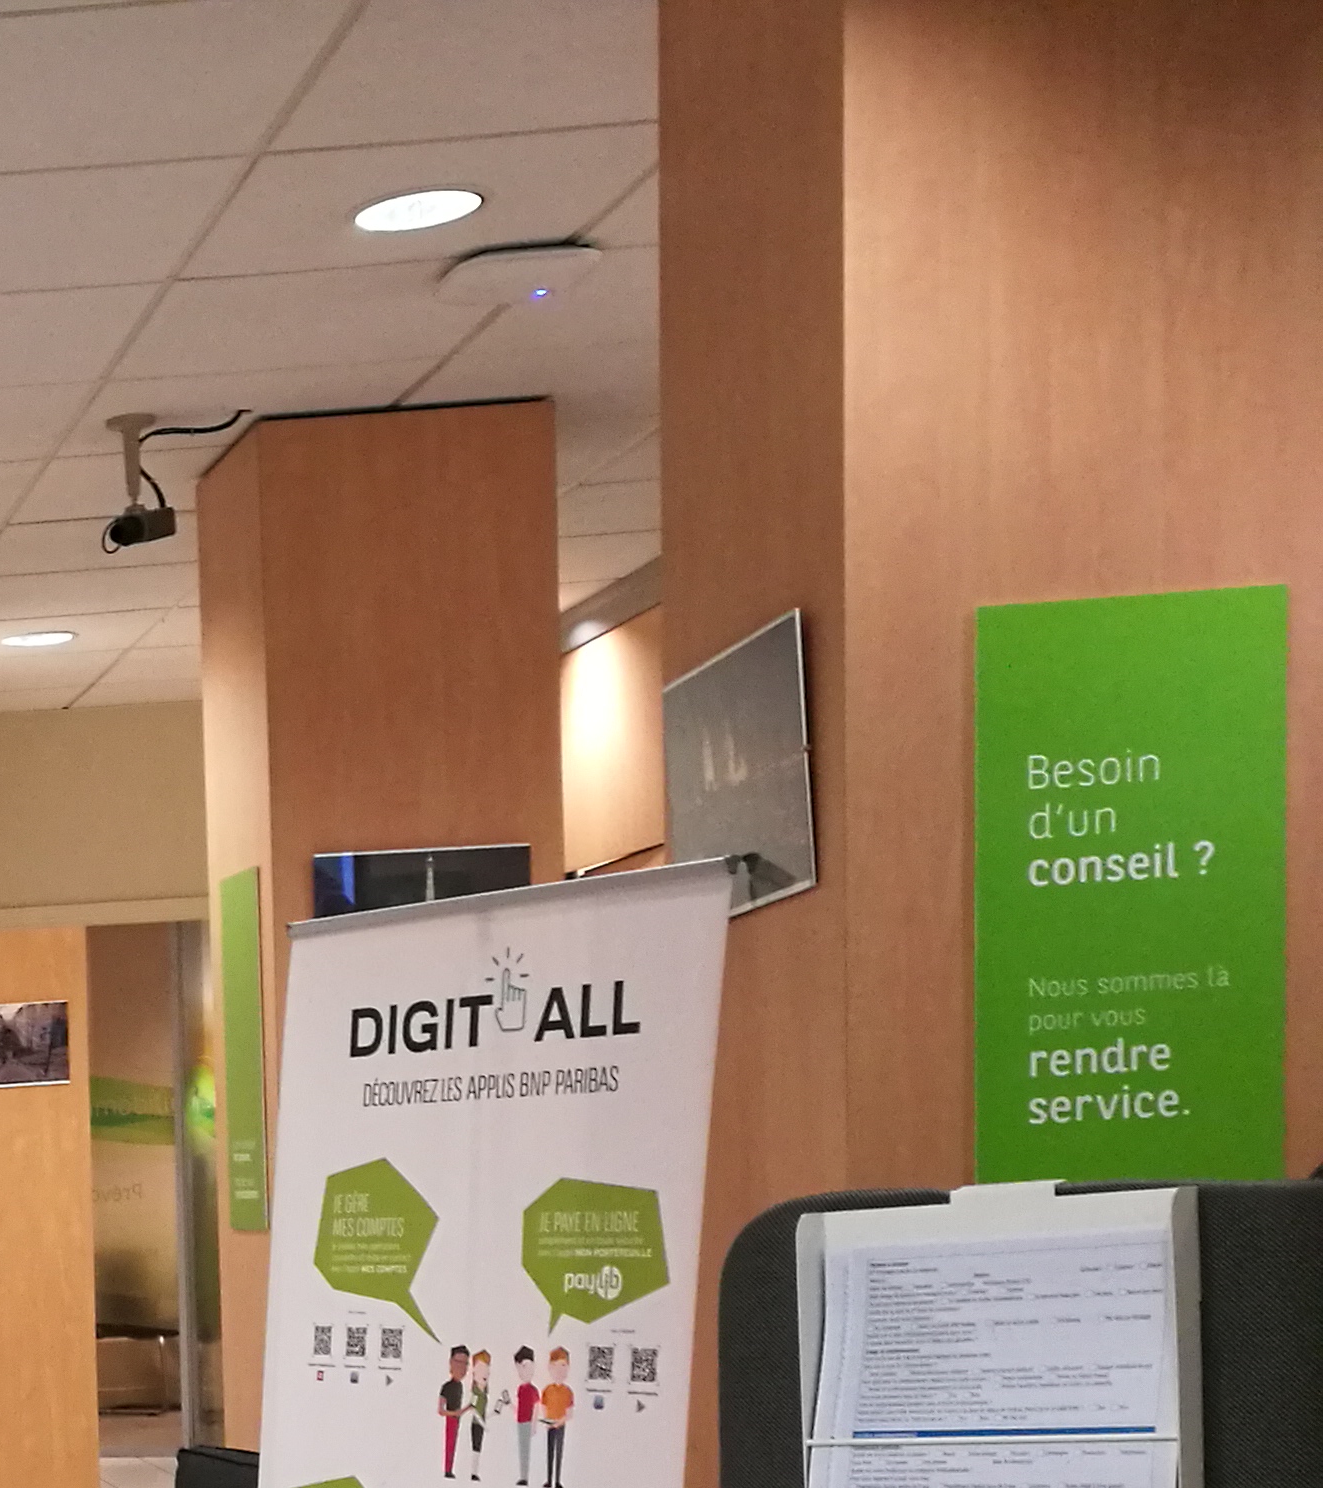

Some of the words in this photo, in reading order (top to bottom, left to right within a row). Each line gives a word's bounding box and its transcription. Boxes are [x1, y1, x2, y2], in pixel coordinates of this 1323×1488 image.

[1027, 748, 1161, 790] Besoin
[1028, 802, 1117, 839] d'un
[1028, 841, 1180, 887] conseil
[1193, 839, 1216, 876] ?
[1028, 977, 1089, 998] Nous
[1097, 971, 1199, 995] sommes
[1208, 966, 1231, 988] là
[349, 993, 495, 1059] DIGIT
[533, 980, 641, 1042] ALL
[1028, 1011, 1083, 1036] pour
[1090, 1008, 1146, 1027] vous
[1028, 1037, 1172, 1078] rendre
[363, 1078, 439, 1108] DÉCOUVREZ
[440, 1074, 464, 1104] LES
[466, 1072, 516, 1102] APPLIS
[519, 1070, 552, 1098] BNP
[554, 1065, 621, 1096] PARIBAS
[1028, 1084, 1191, 1125] service.
[332, 1218, 355, 1238] MES
[356, 1216, 406, 1238] COMPTES
[539, 1212, 552, 1233] JE
[554, 1211, 581, 1233] PAYE
[584, 1211, 602, 1232] EN
[605, 1210, 640, 1232] LIGNE
